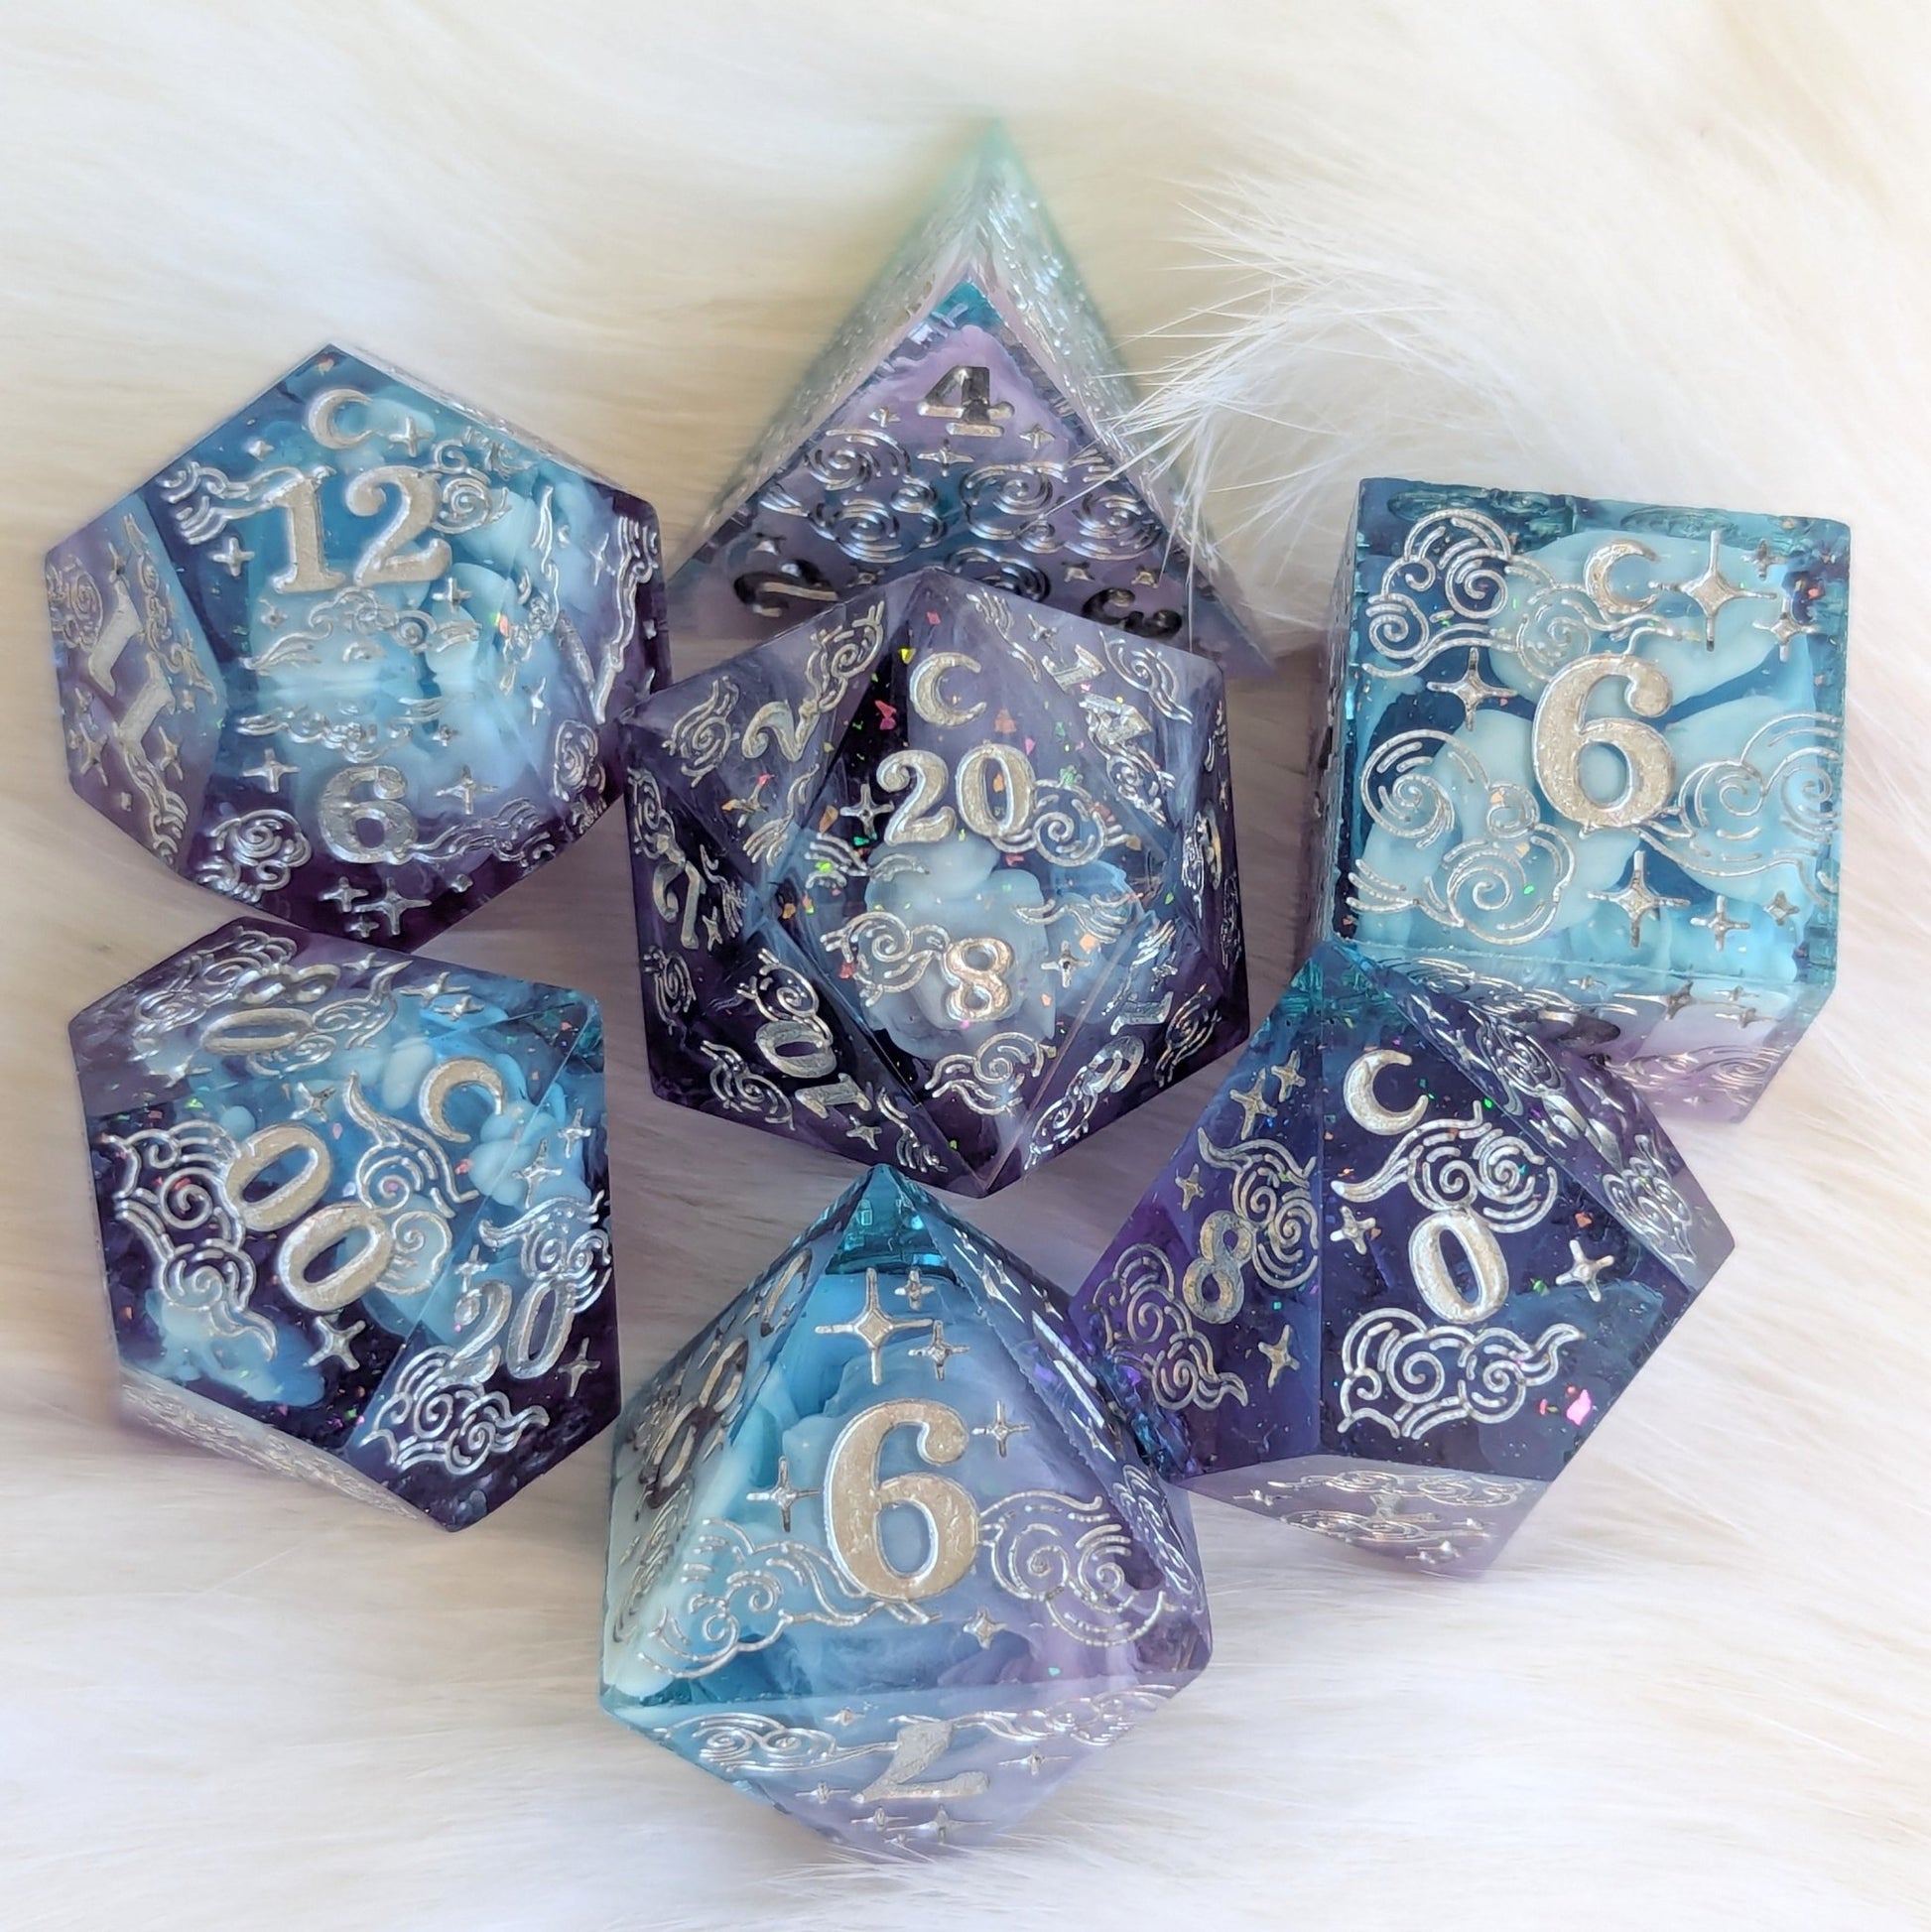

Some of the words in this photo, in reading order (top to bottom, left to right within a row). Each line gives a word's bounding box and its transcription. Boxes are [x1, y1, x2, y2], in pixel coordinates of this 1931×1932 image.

[918, 365, 1015, 437] 4
[268, 463, 451, 594] 12
[876, 741, 1036, 846] 20
[1533, 650, 1673, 828] 6
[316, 764, 418, 864] 6
[942, 937, 1014, 1022] 8
[755, 1020, 872, 1119] 10
[225, 1124, 395, 1312] 00
[1182, 1210, 1253, 1325] 8
[1407, 1208, 1508, 1324] 0
[453, 1279, 572, 1381] 20
[823, 1397, 981, 1601] 6
